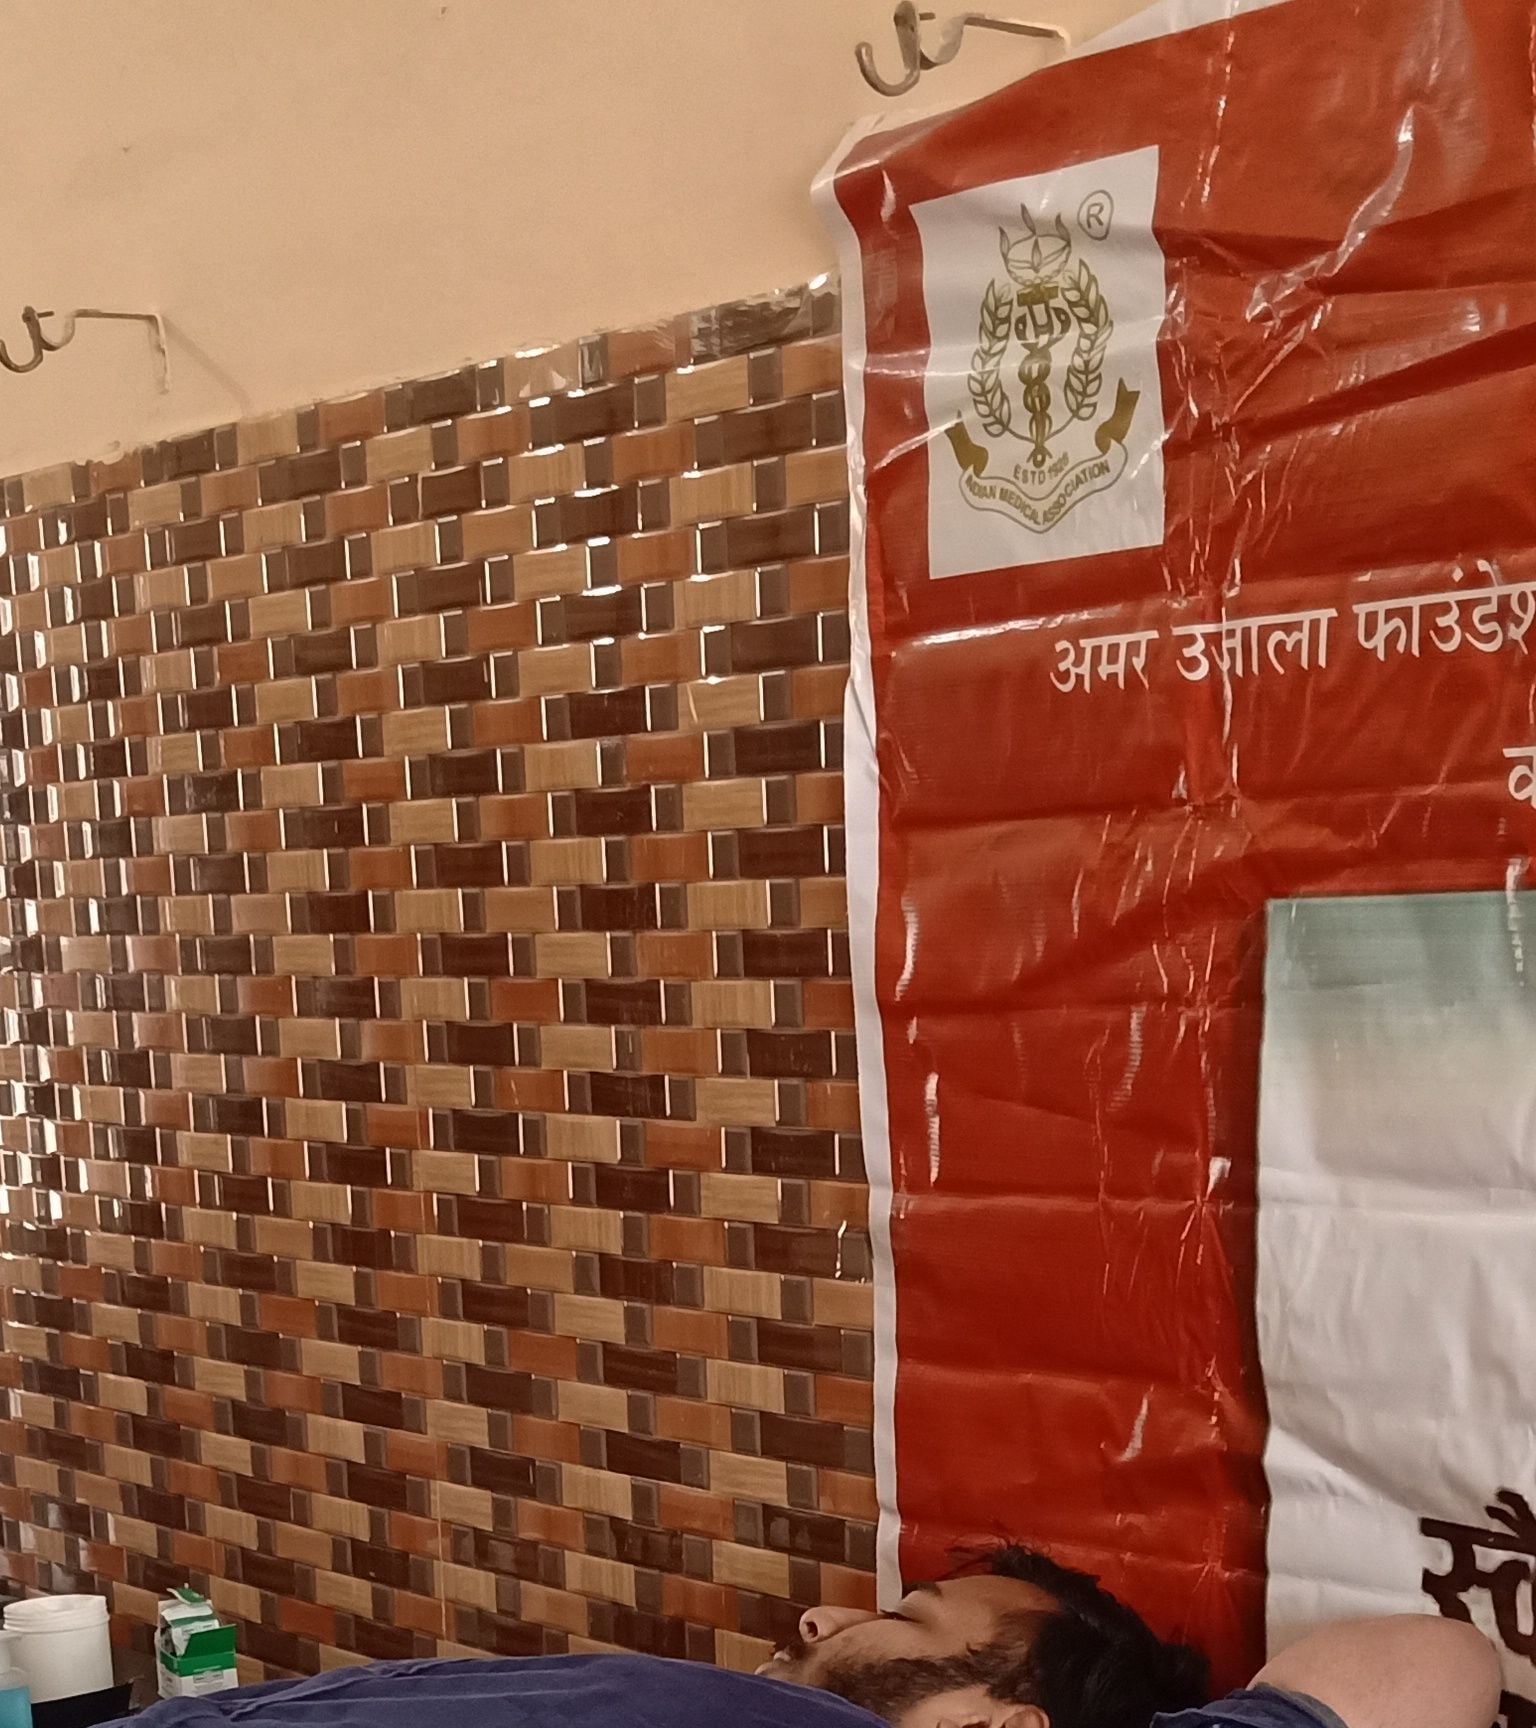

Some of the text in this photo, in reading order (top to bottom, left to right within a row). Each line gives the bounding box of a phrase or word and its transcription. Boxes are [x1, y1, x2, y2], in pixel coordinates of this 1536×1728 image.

[999, 487, 1041, 525] MEDICAL
[1043, 459, 1110, 525] ASSOCIATION
[1013, 463, 1046, 486] ESTD
[1049, 630, 1159, 694] अमर
[1170, 607, 1339, 681] उजाला
